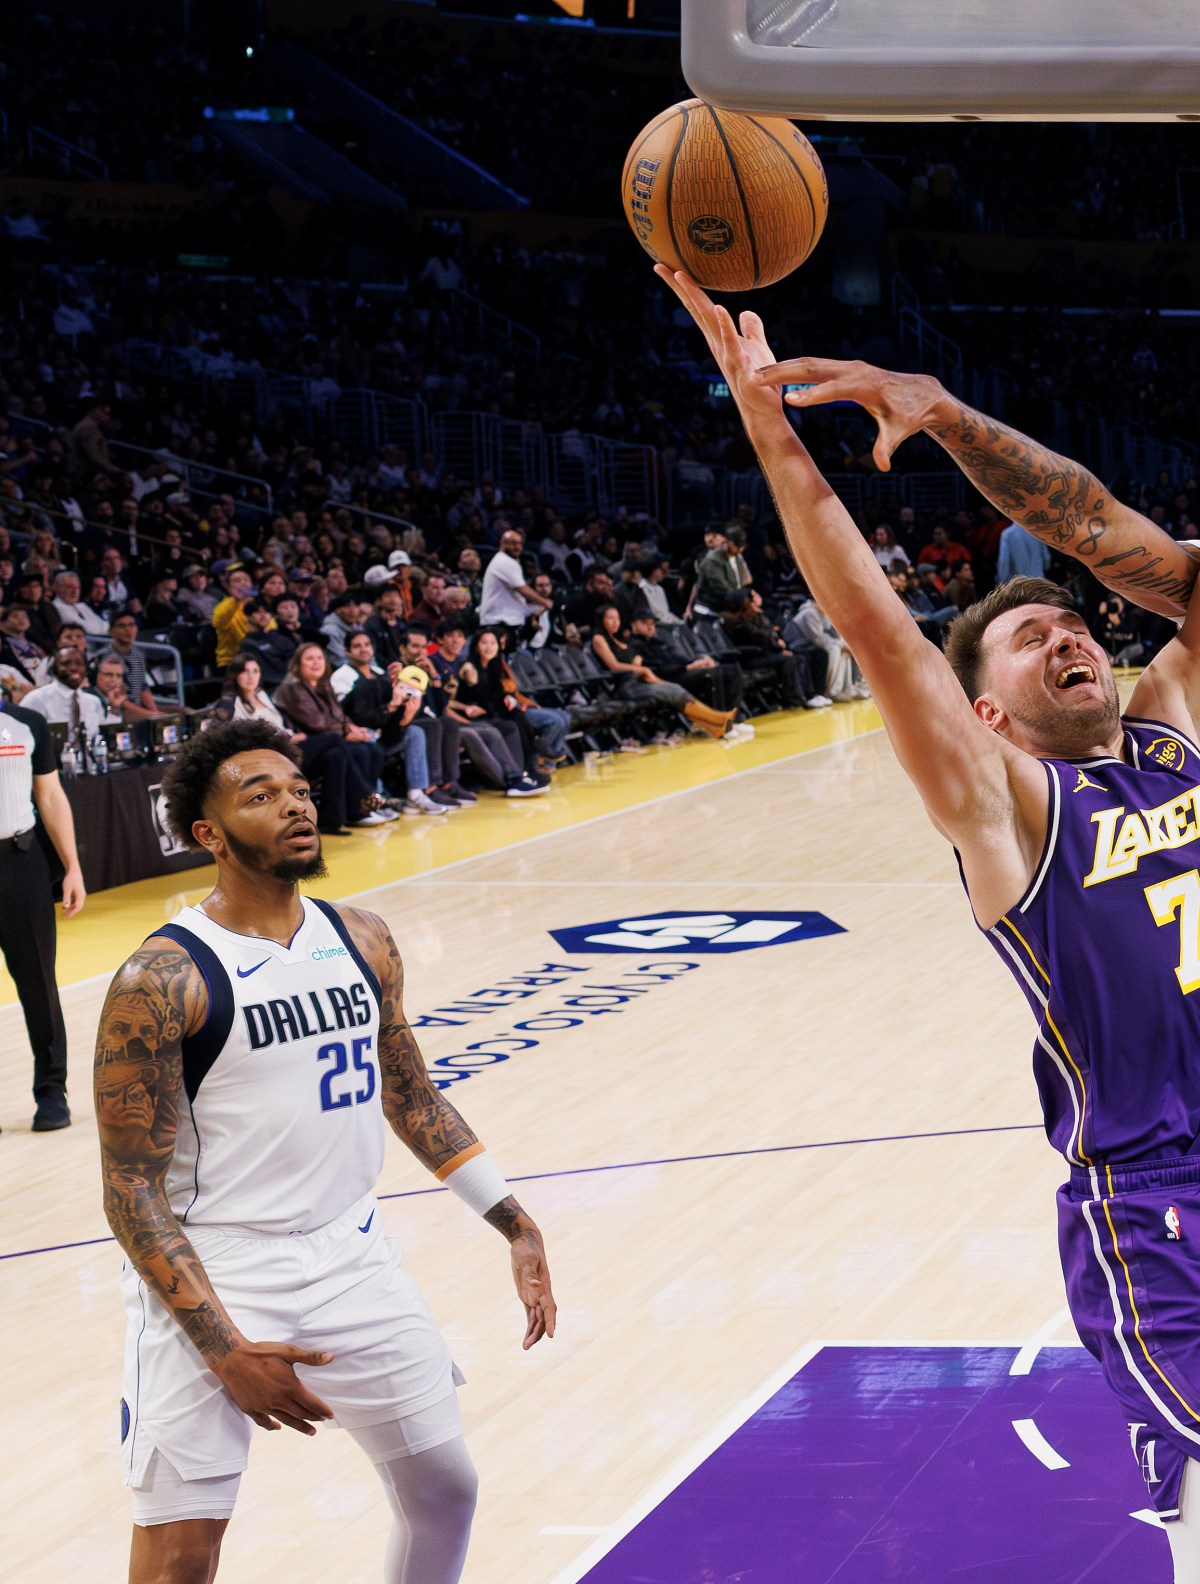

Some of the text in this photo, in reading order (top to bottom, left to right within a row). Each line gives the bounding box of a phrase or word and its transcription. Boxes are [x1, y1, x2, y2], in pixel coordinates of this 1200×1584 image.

[631, 158, 661, 263] Wilso
[311, 946, 348, 961] chime
[242, 982, 372, 1052] DALLAS
[410, 962, 592, 1028] ARENA
[316, 1035, 376, 1114] 25
